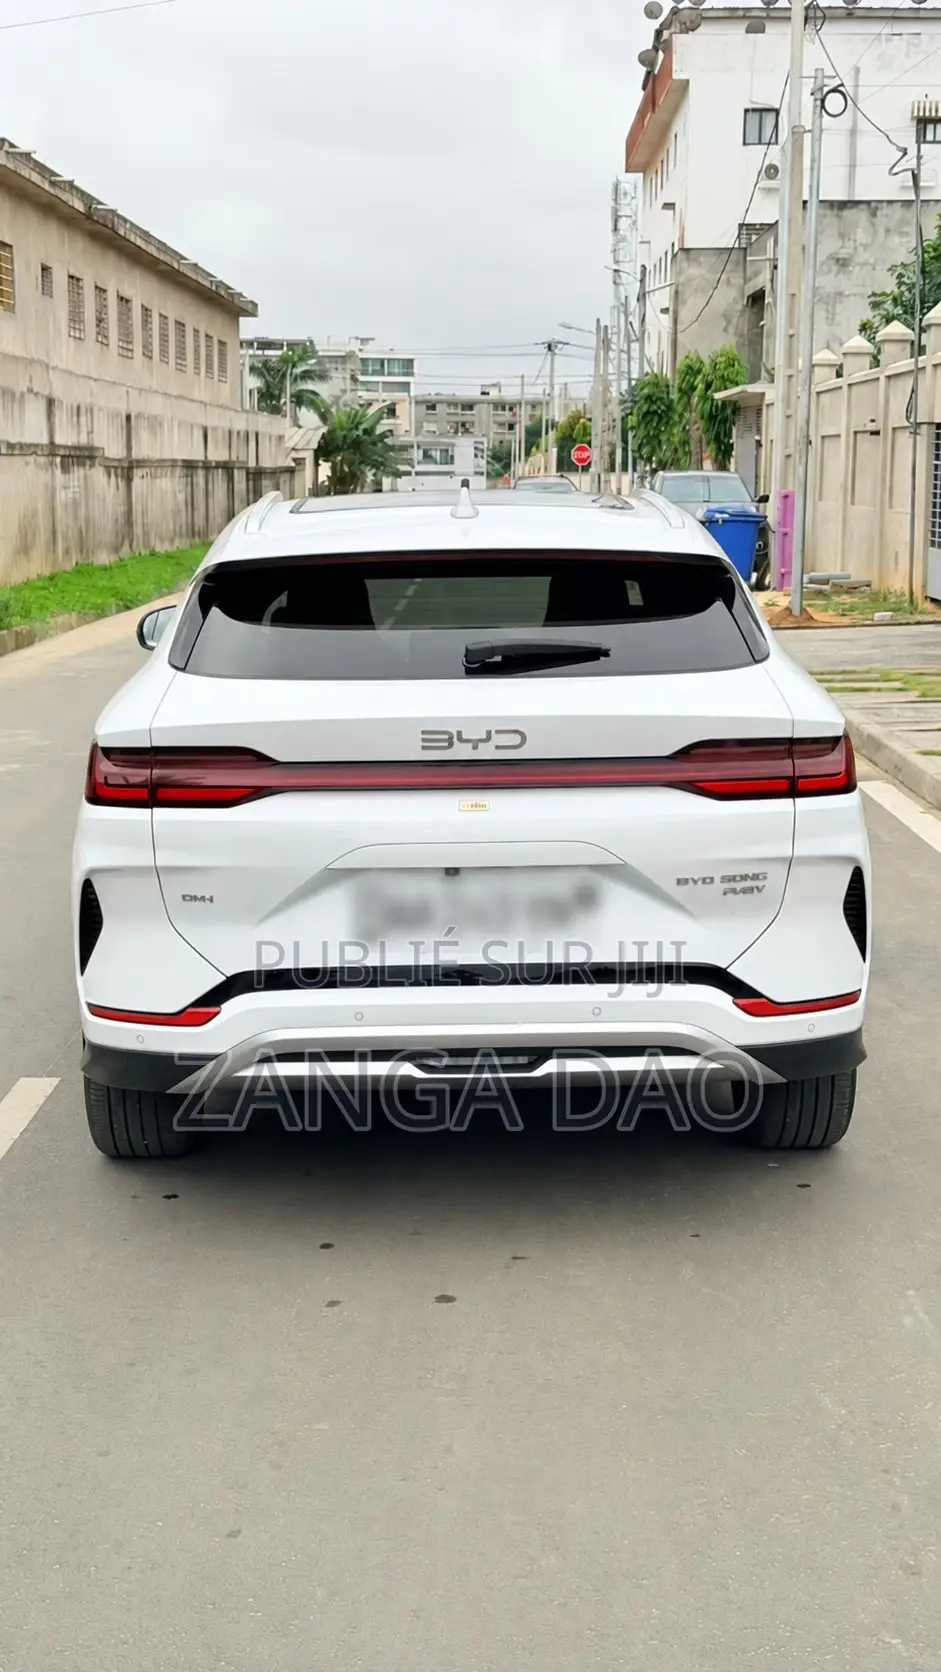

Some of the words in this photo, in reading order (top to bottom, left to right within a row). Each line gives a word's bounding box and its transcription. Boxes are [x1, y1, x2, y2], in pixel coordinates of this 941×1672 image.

[574, 450, 591, 459] STOP
[421, 729, 527, 750] BYD
[676, 876, 715, 886] BYD
[720, 872, 768, 884] SONG
